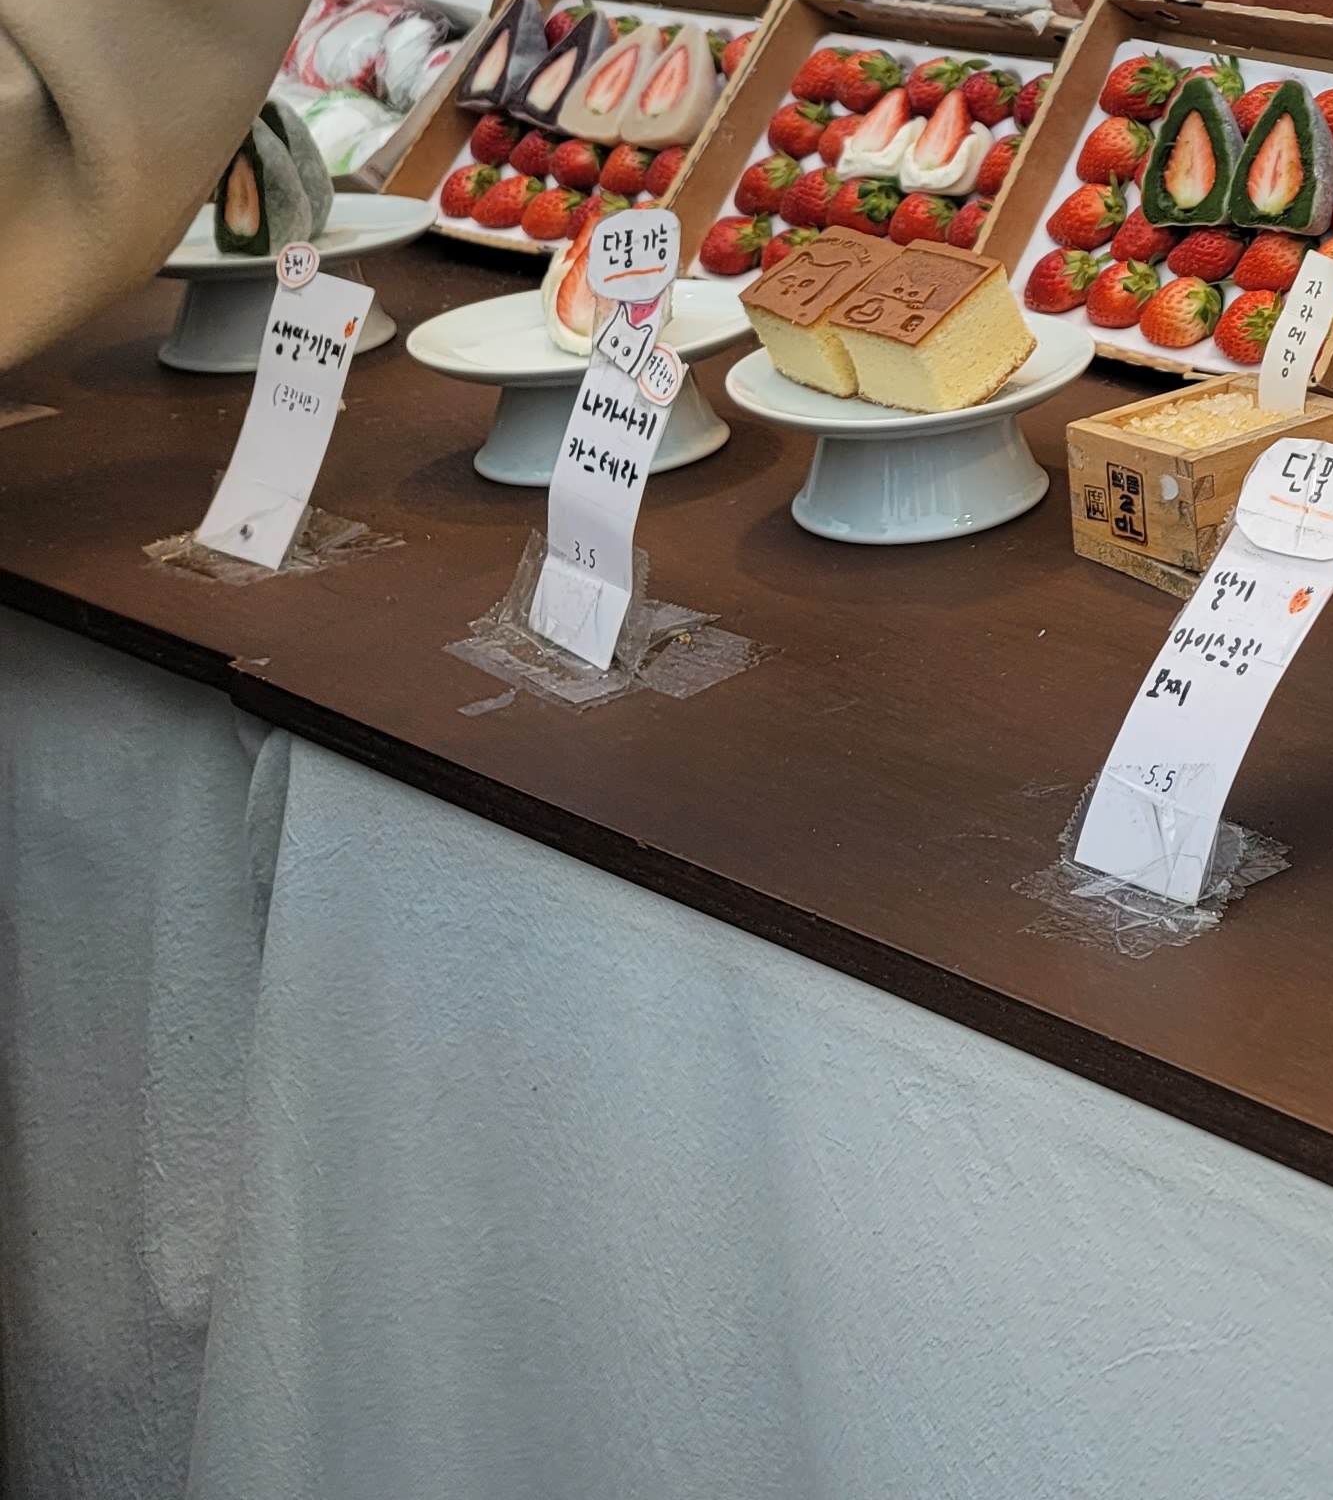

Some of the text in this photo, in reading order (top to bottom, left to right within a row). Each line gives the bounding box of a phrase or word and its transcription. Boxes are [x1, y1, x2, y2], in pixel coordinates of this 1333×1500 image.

[643, 223, 668, 260] 가능
[582, 387, 658, 441] 나가사키
[569, 437, 639, 489] 카스테라
[574, 540, 597, 569] 3.5
[1213, 571, 1257, 611] 딸기
[1173, 627, 1263, 676] 아이스크림
[1145, 666, 1191, 708] 모찌
[1144, 764, 1176, 793] 5.5
